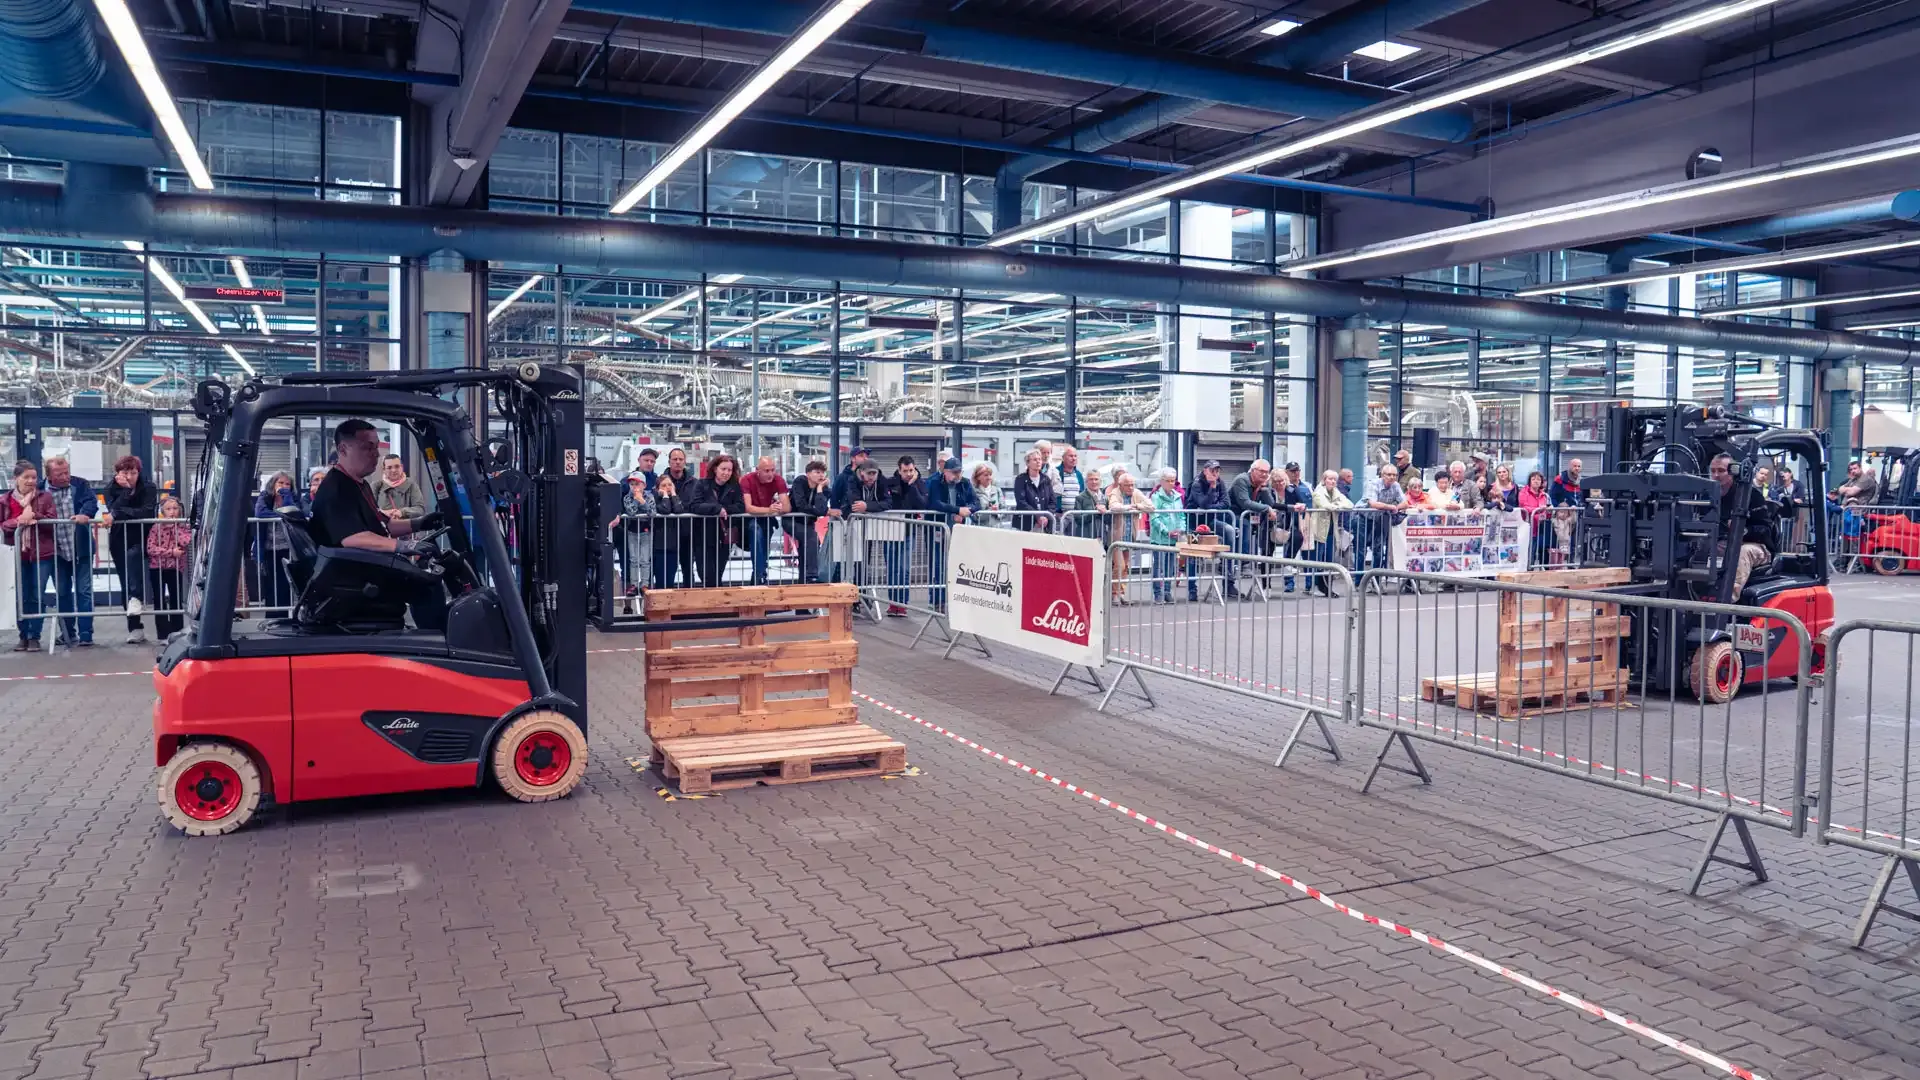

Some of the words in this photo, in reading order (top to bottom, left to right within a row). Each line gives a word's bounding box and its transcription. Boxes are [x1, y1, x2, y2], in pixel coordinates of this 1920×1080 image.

[216, 287, 260, 296] Chemnitzer
[550, 389, 580, 399] Linde
[1025, 556, 1037, 566] Linde
[1037, 558, 1054, 569] Material
[1055, 560, 1075, 574] Handling
[1032, 599, 1086, 637] Linde
[382, 717, 420, 729] Linde
